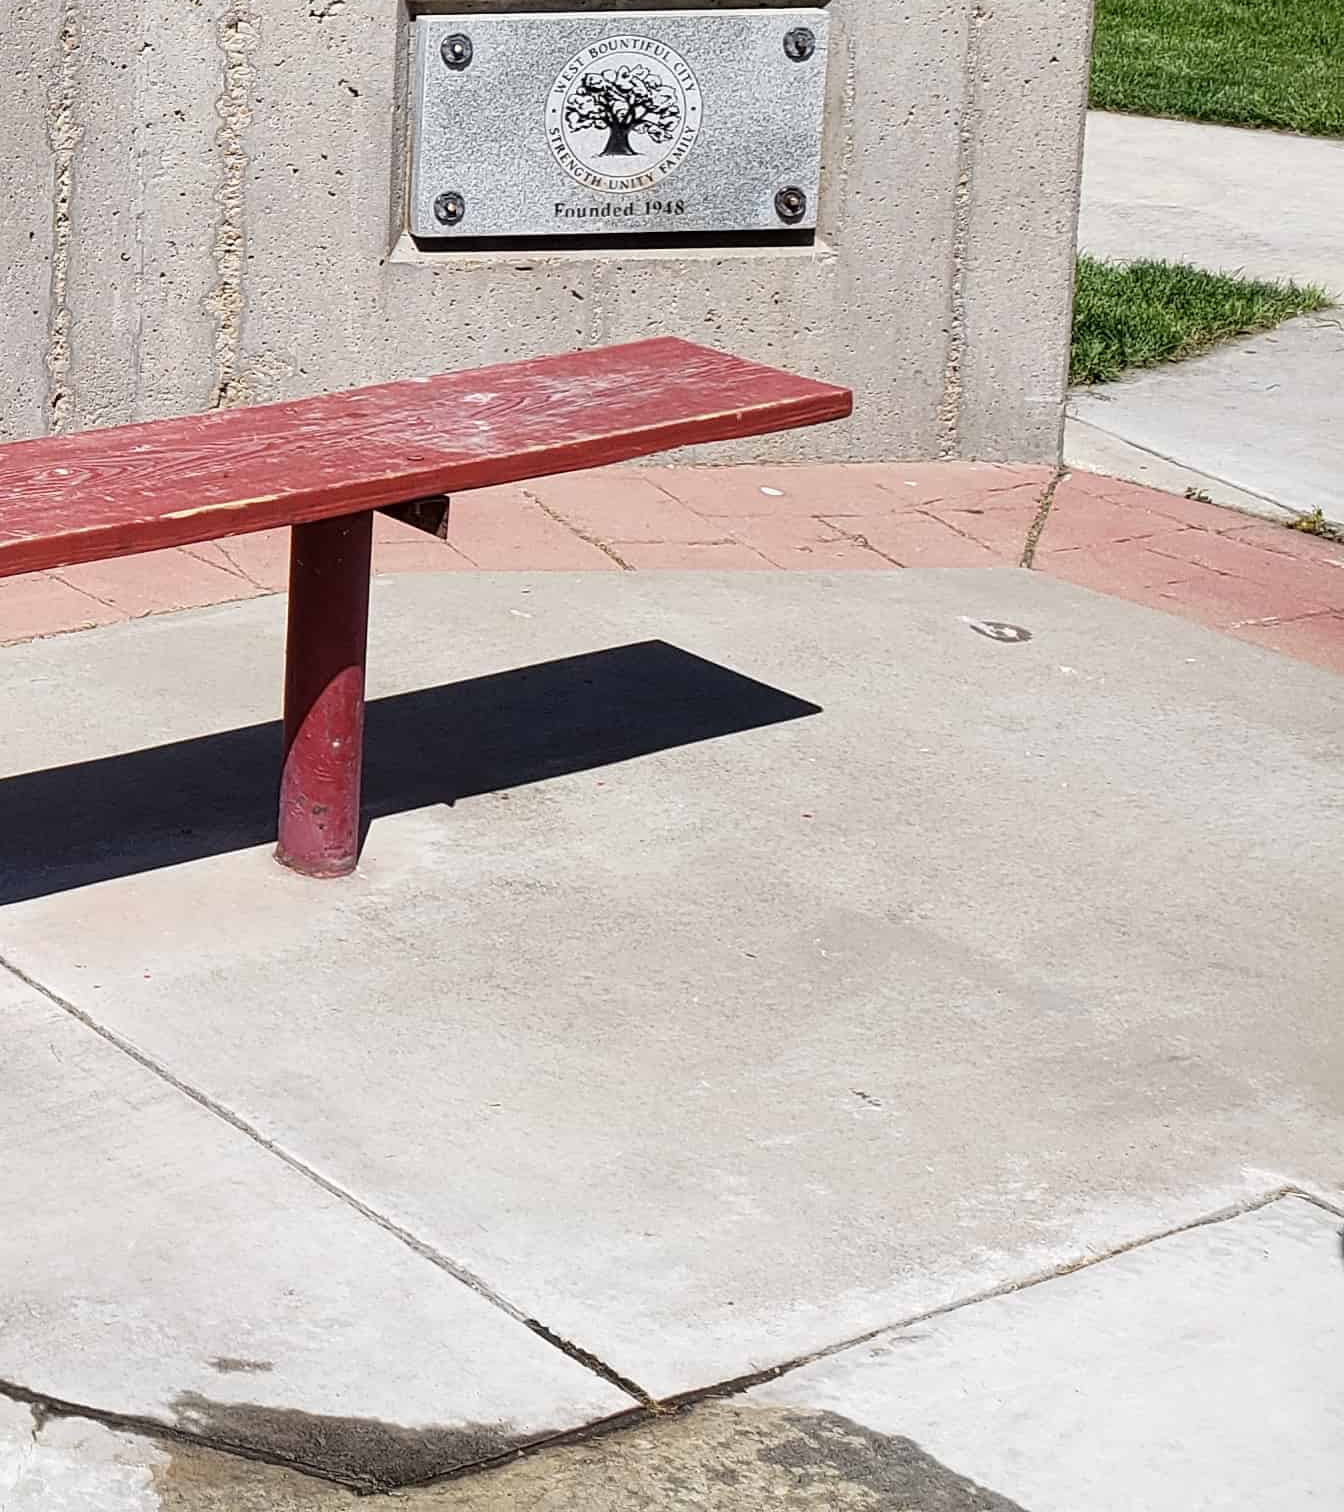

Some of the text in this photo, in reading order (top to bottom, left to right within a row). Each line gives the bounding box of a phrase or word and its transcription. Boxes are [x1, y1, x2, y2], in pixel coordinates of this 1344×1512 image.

[554, 39, 698, 94] WEST BOUNTIFUL CITY
[548, 125, 696, 189] STRENGTH UNITY FAMILY
[554, 199, 685, 218] Founded 1948
